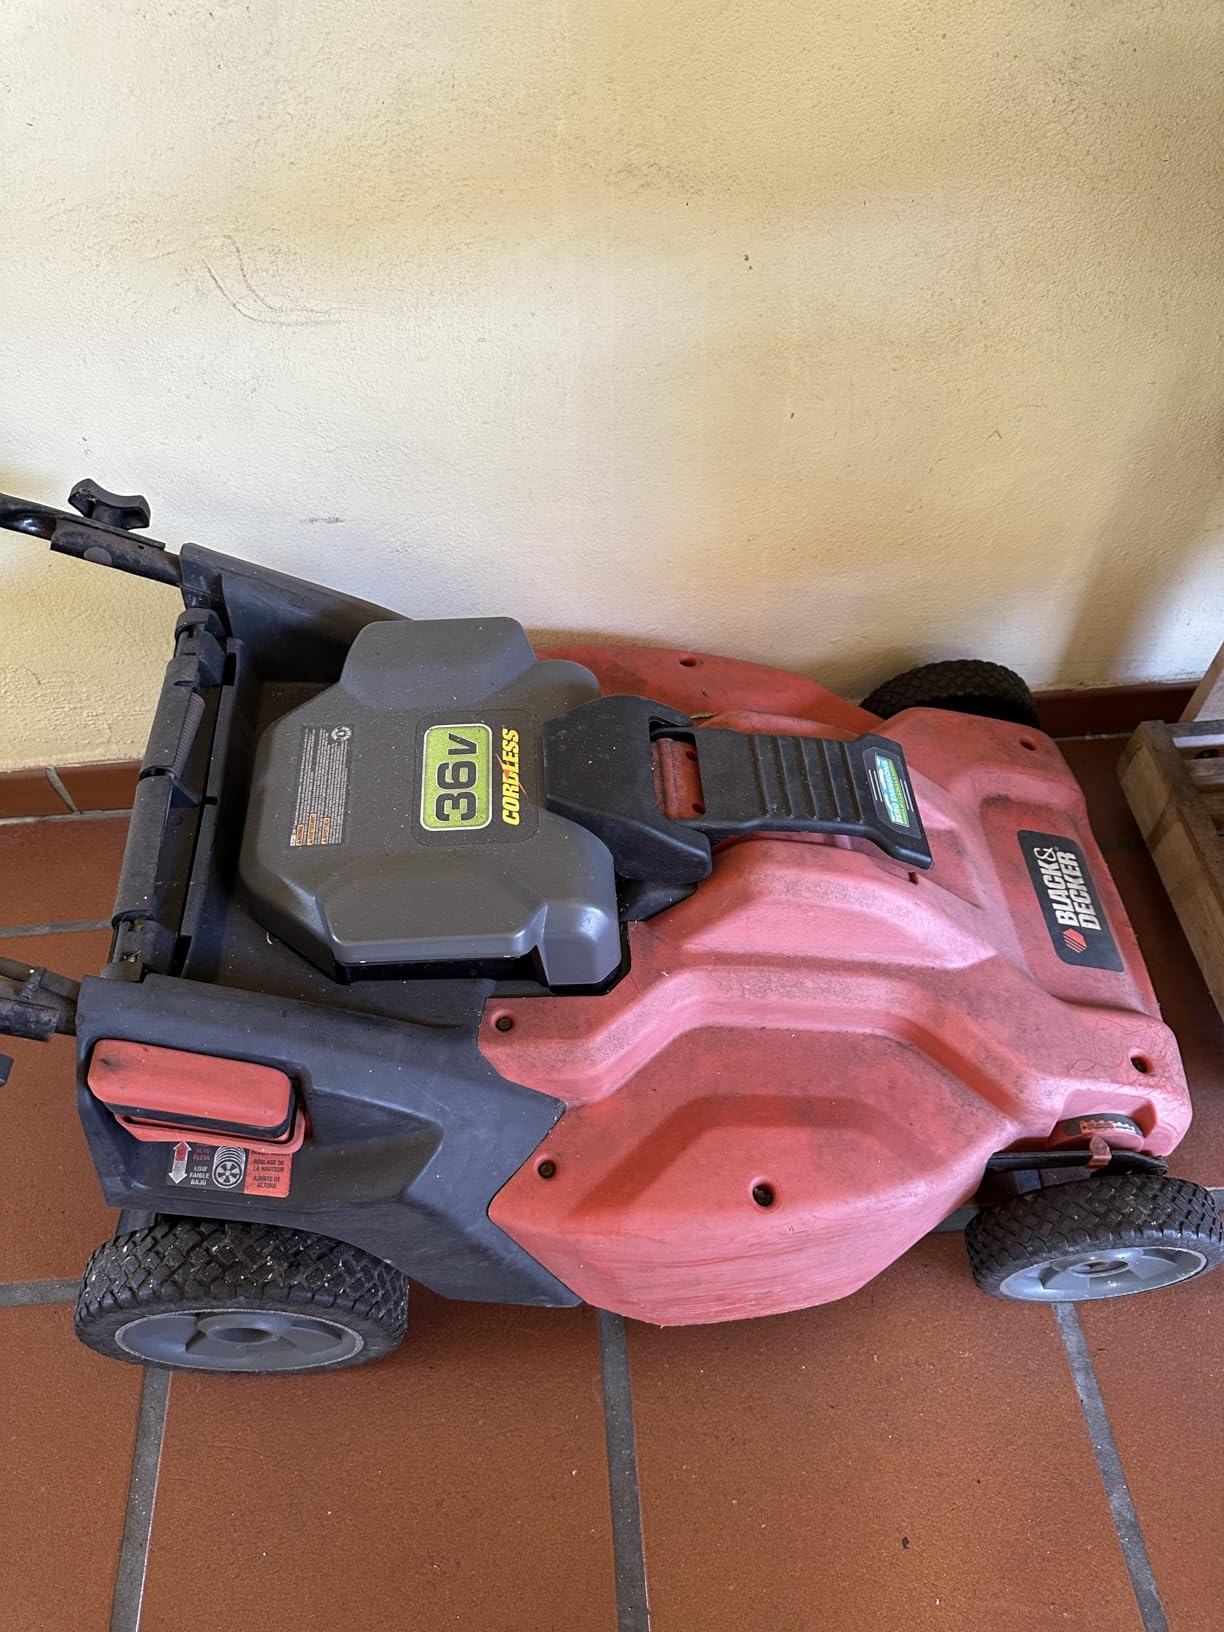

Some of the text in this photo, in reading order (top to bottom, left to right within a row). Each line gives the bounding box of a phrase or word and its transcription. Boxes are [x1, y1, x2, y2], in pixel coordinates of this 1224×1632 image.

[502, 727, 521, 826] CORDLESS
[1037, 860, 1080, 927] BLACK
[1056, 851, 1102, 931] DECKER
